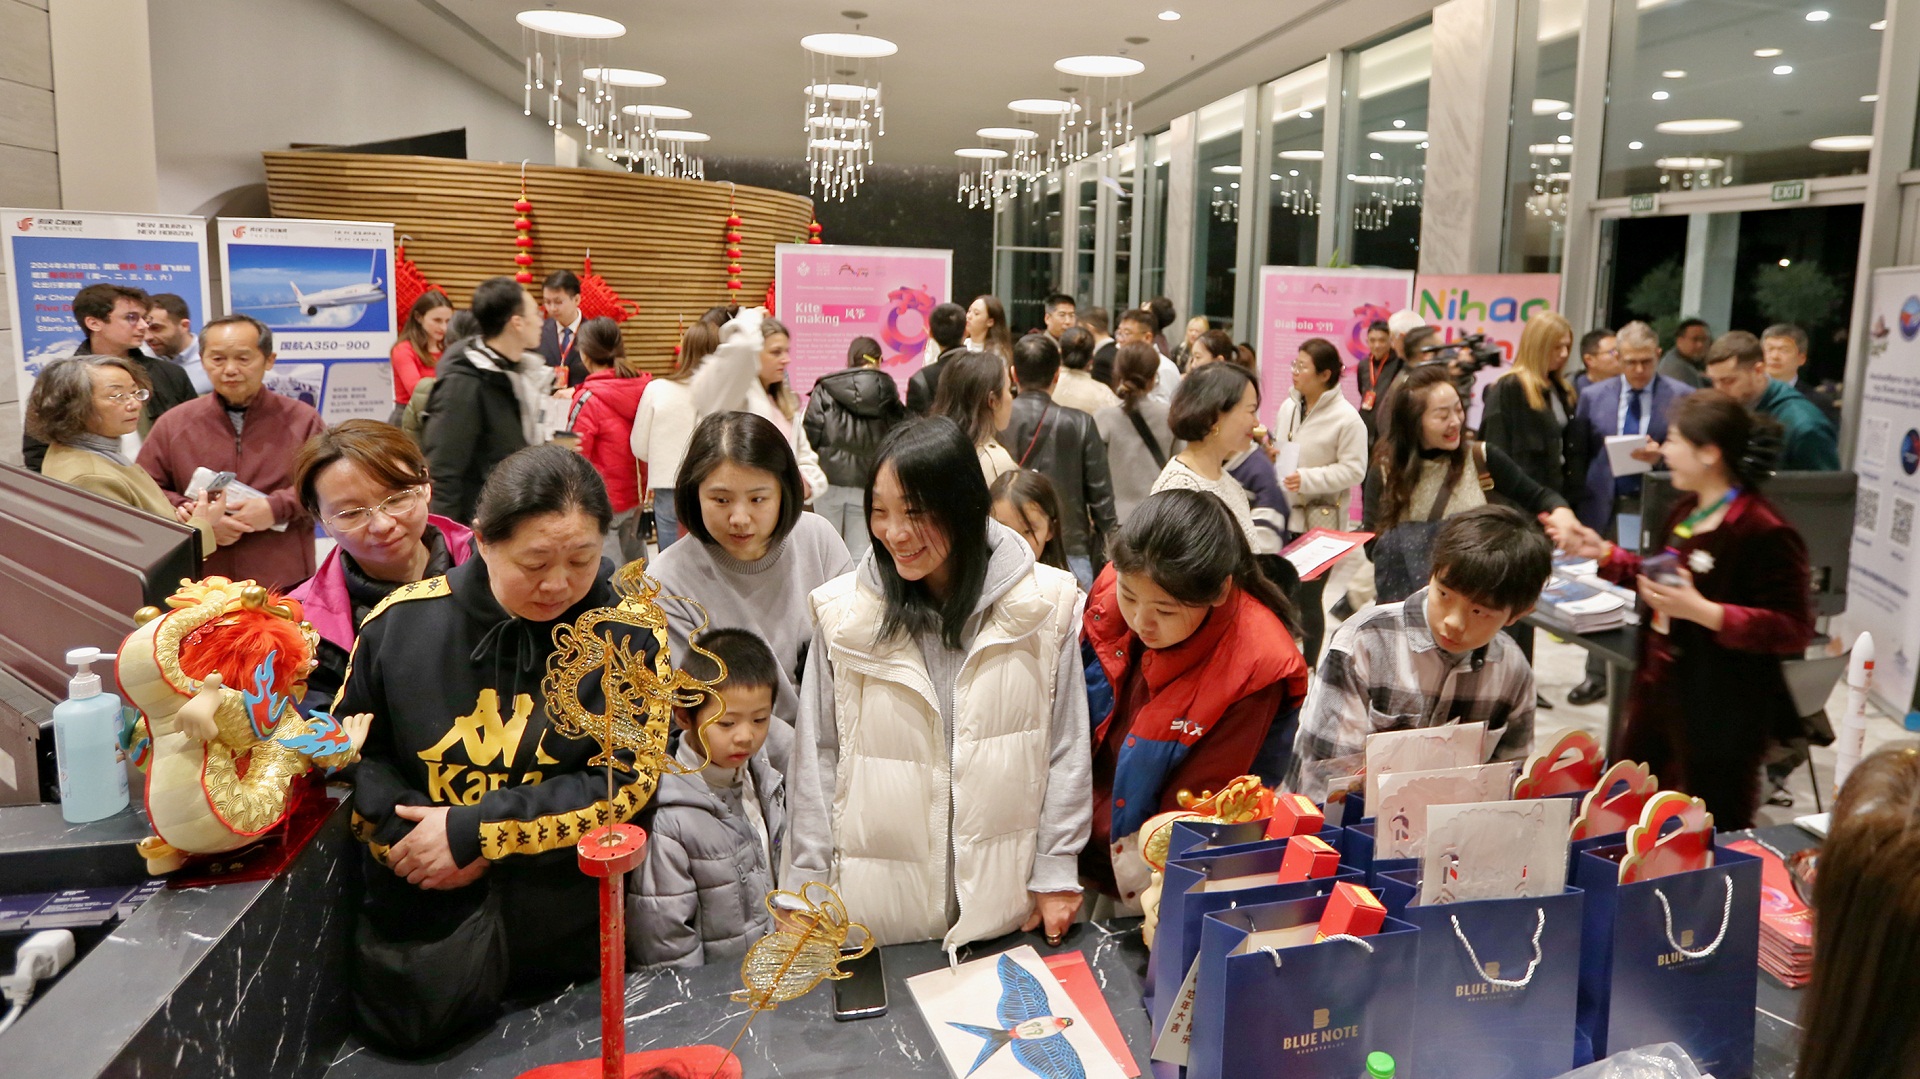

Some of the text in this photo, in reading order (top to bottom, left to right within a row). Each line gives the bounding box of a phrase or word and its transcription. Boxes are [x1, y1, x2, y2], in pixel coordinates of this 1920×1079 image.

[1774, 184, 1803, 200] EXIT
[35, 304, 59, 312] Five
[795, 302, 820, 313] Kite
[795, 314, 840, 327] making
[1274, 318, 1314, 331] Diabolo
[37, 325, 74, 333] Starting
[1657, 951, 1685, 967] BLUE
[1455, 983, 1488, 997] BLUE
[1283, 1032, 1318, 1050] BLUE
[1321, 1025, 1359, 1043] NOTE
